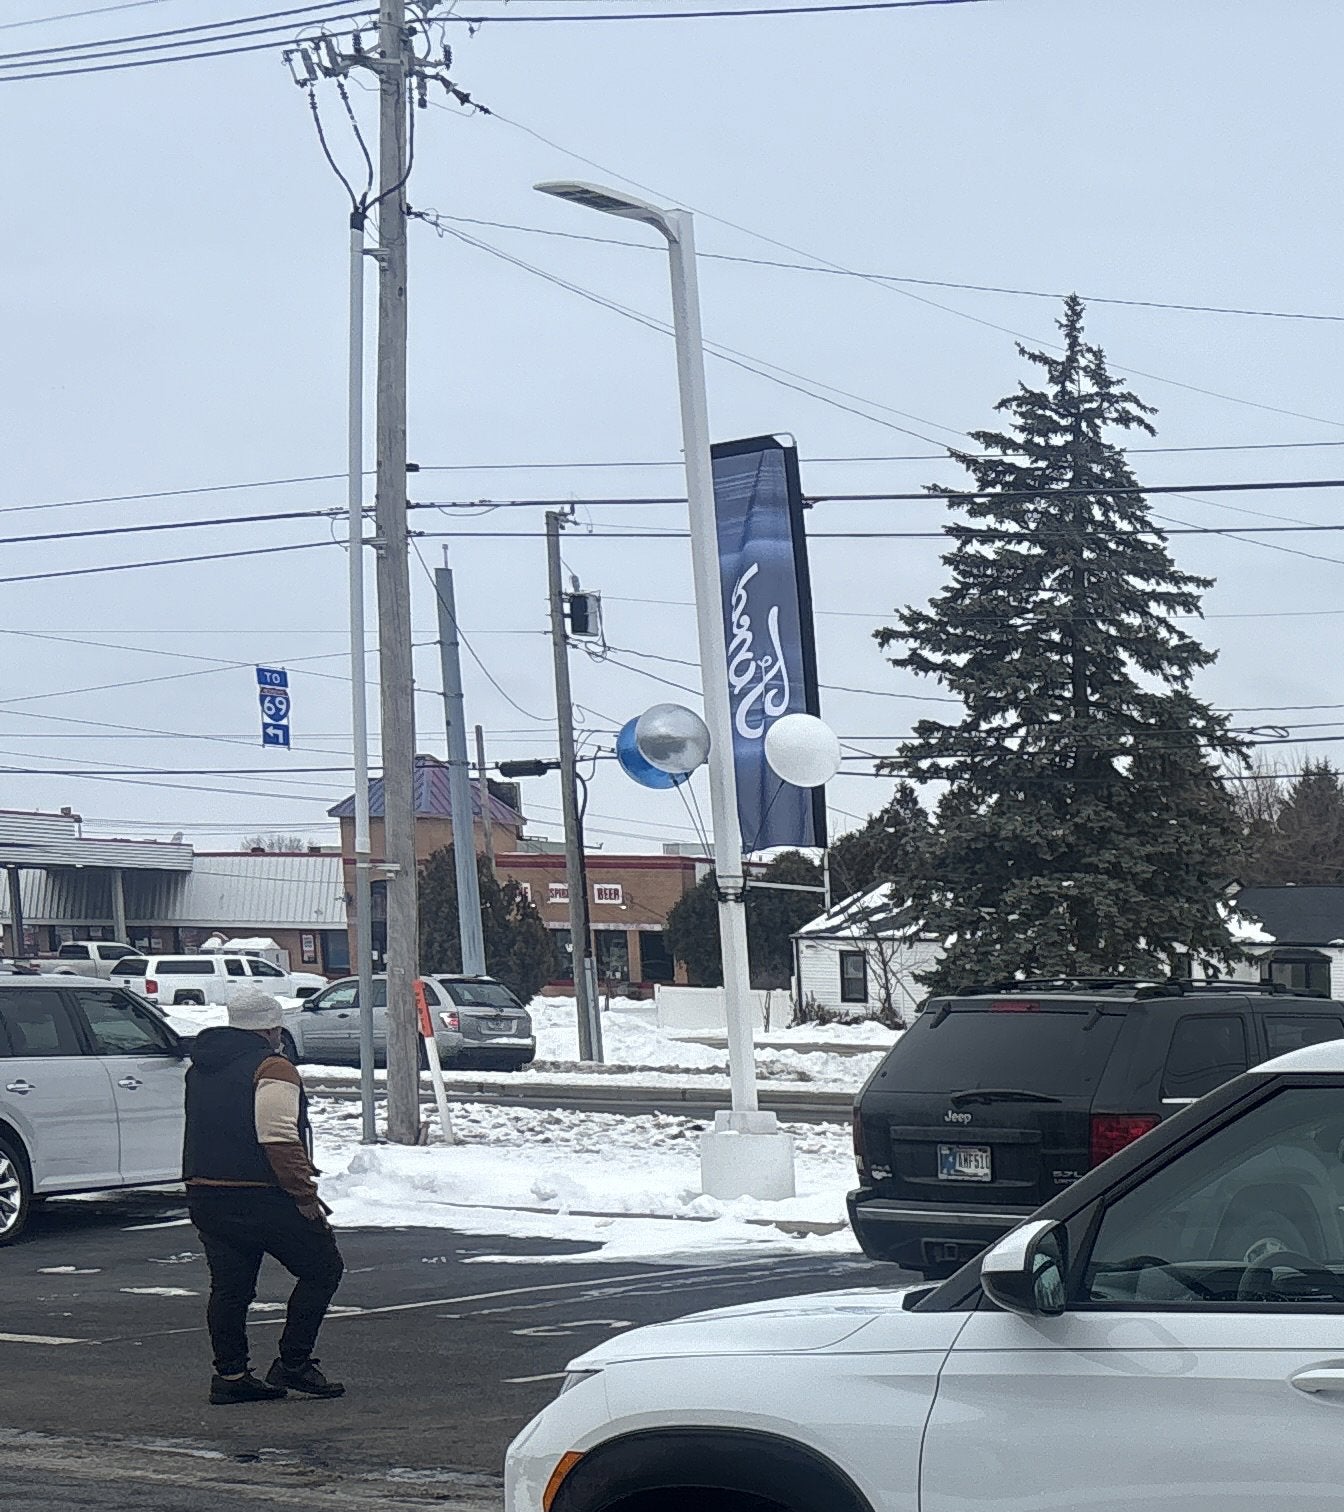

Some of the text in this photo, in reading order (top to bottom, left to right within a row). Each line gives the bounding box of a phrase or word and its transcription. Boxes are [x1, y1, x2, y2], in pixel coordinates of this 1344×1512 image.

[264, 672, 280, 684] TO
[263, 696, 287, 716] 69
[596, 887, 620, 900] BEER
[944, 1109, 972, 1125] Jeep
